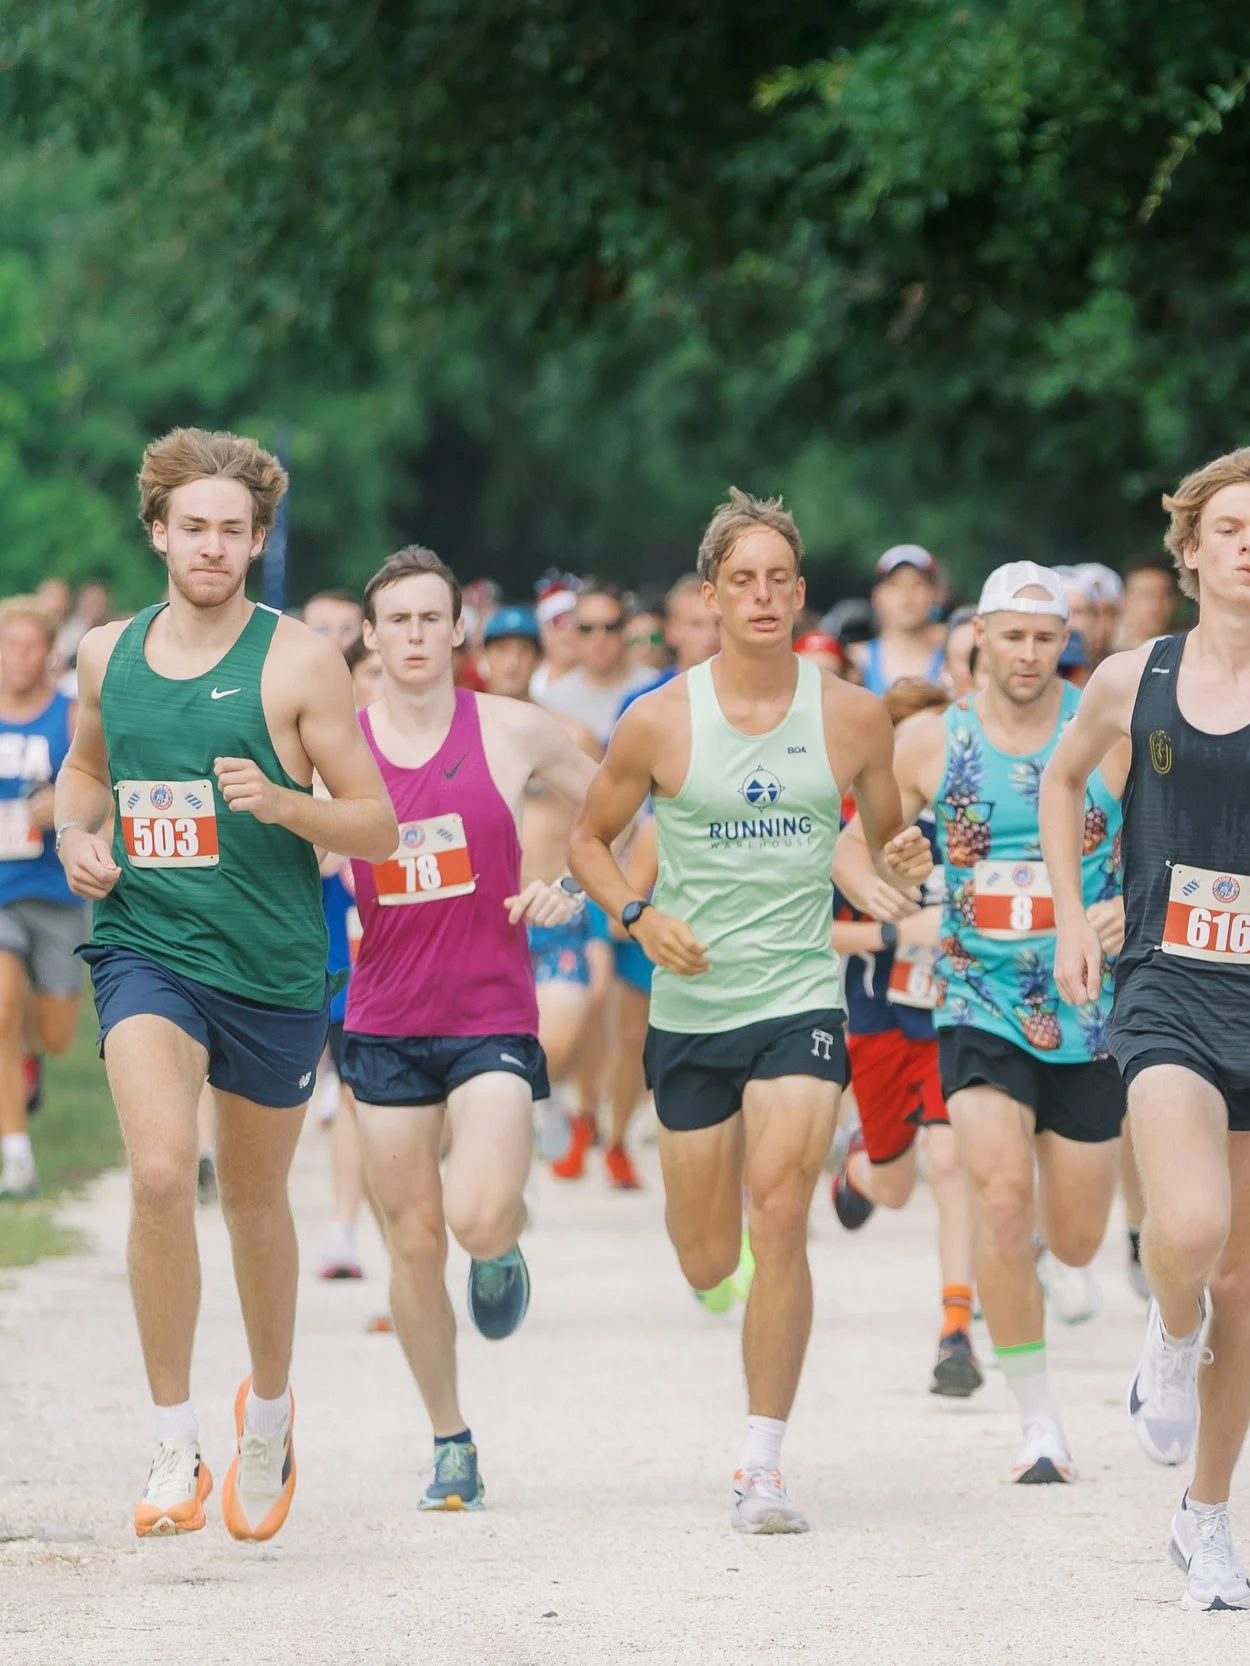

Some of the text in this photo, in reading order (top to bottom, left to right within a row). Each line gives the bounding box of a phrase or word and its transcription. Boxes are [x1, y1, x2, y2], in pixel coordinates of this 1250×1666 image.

[133, 818, 199, 857] 503
[709, 816, 812, 840] RUNNING
[398, 853, 442, 893] 78
[1010, 895, 1034, 931] 8
